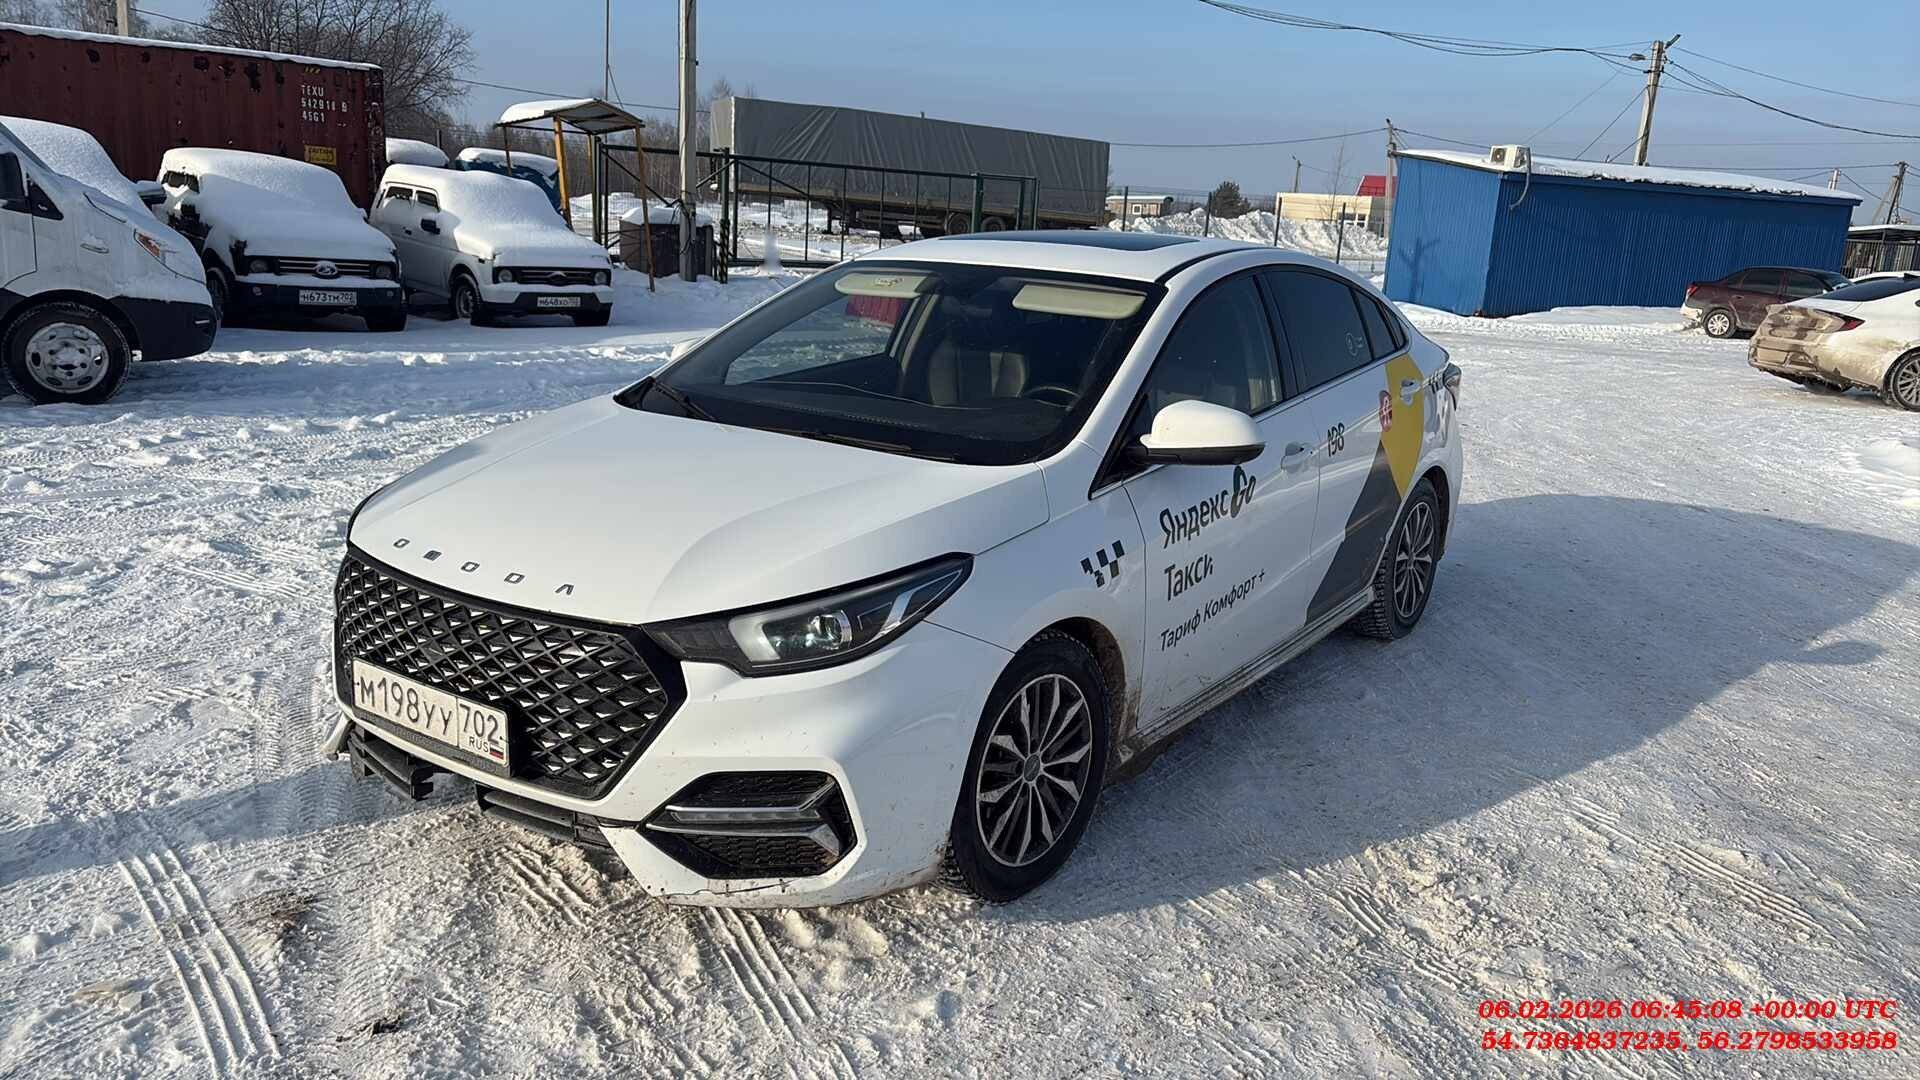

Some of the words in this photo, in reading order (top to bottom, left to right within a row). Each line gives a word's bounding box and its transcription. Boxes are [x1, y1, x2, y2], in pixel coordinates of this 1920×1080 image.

[301, 85, 324, 97] TEXU
[1327, 422, 1345, 457] 198
[1159, 489, 1229, 549] Яндекс
[1164, 553, 1214, 601] Такси
[1160, 610, 1201, 651] Тариф
[468, 736, 489, 753] RUS
